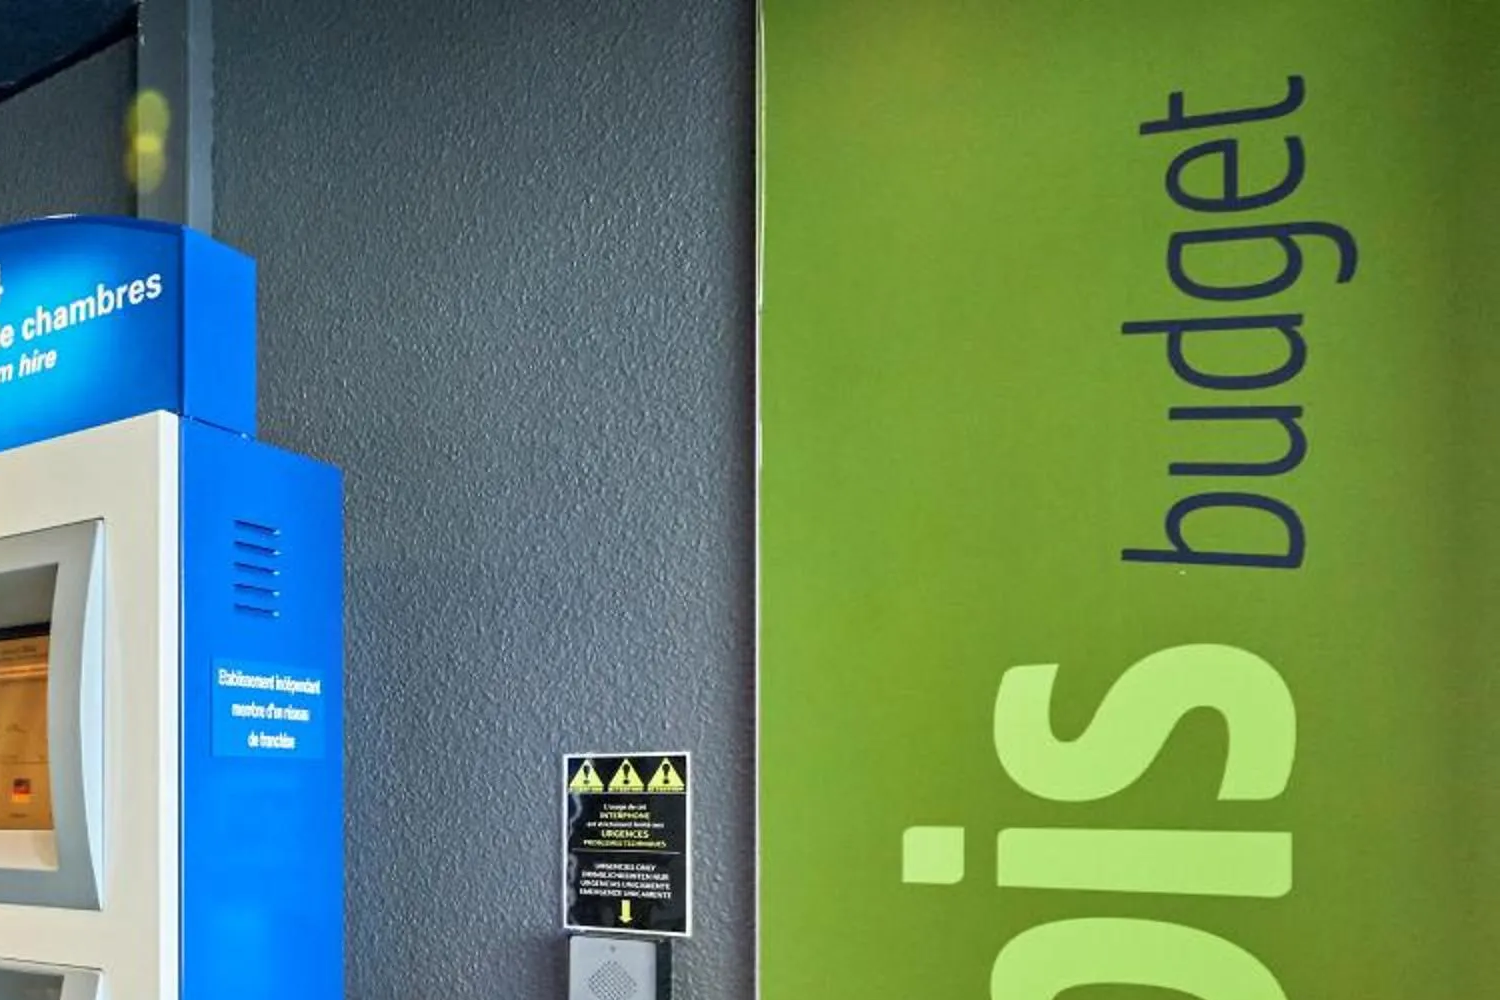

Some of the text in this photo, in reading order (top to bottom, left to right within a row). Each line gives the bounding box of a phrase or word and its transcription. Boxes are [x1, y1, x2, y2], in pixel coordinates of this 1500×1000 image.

[21, 271, 163, 342] chambres
[1121, 75, 1358, 569] budget
[18, 347, 58, 379] hire
[601, 829, 650, 839] URGENCES
